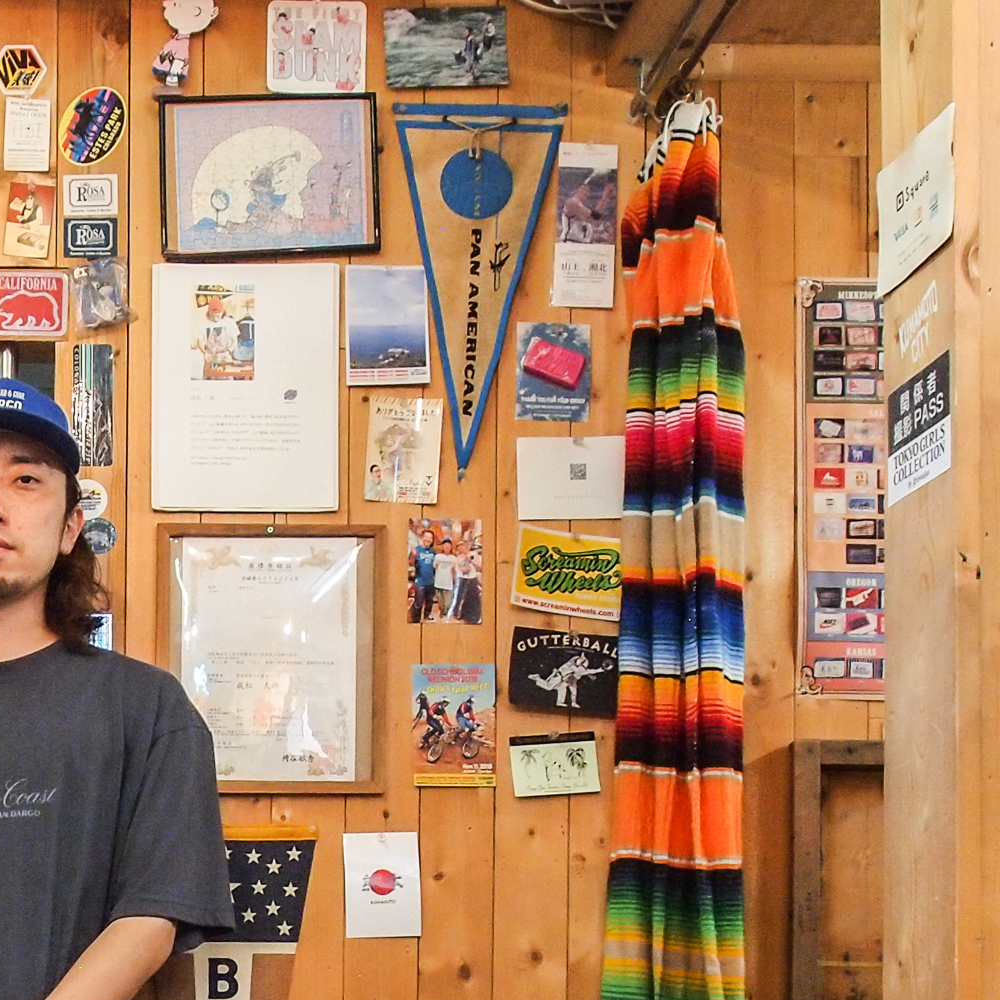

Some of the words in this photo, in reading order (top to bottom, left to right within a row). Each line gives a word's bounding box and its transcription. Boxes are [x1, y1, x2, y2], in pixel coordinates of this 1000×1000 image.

[272, 20, 362, 53] SLAM
[273, 49, 361, 82] DUNK
[88, 131, 109, 160] ESTES
[104, 106, 123, 133] PARK
[76, 186, 106, 202] ROSA
[905, 170, 930, 202] Square
[75, 228, 106, 246] ROSA
[468, 228, 485, 276] PAN
[0, 276, 58, 291] CALIFORNIA
[898, 279, 939, 359] KUMAMOTO
[461, 284, 480, 418] AMERICAN
[911, 321, 930, 364] CITY
[893, 442, 920, 471] TOKYO
[919, 423, 946, 454] GIRLS
[893, 440, 946, 487] COLLECTION
[521, 545, 621, 577] Screamin
[524, 569, 623, 595] Wheels
[845, 577, 878, 588] OREGON
[516, 634, 618, 659] GUTTERBALL
[2, 777, 58, 809] Coast
[10, 809, 41, 818] DARGO
